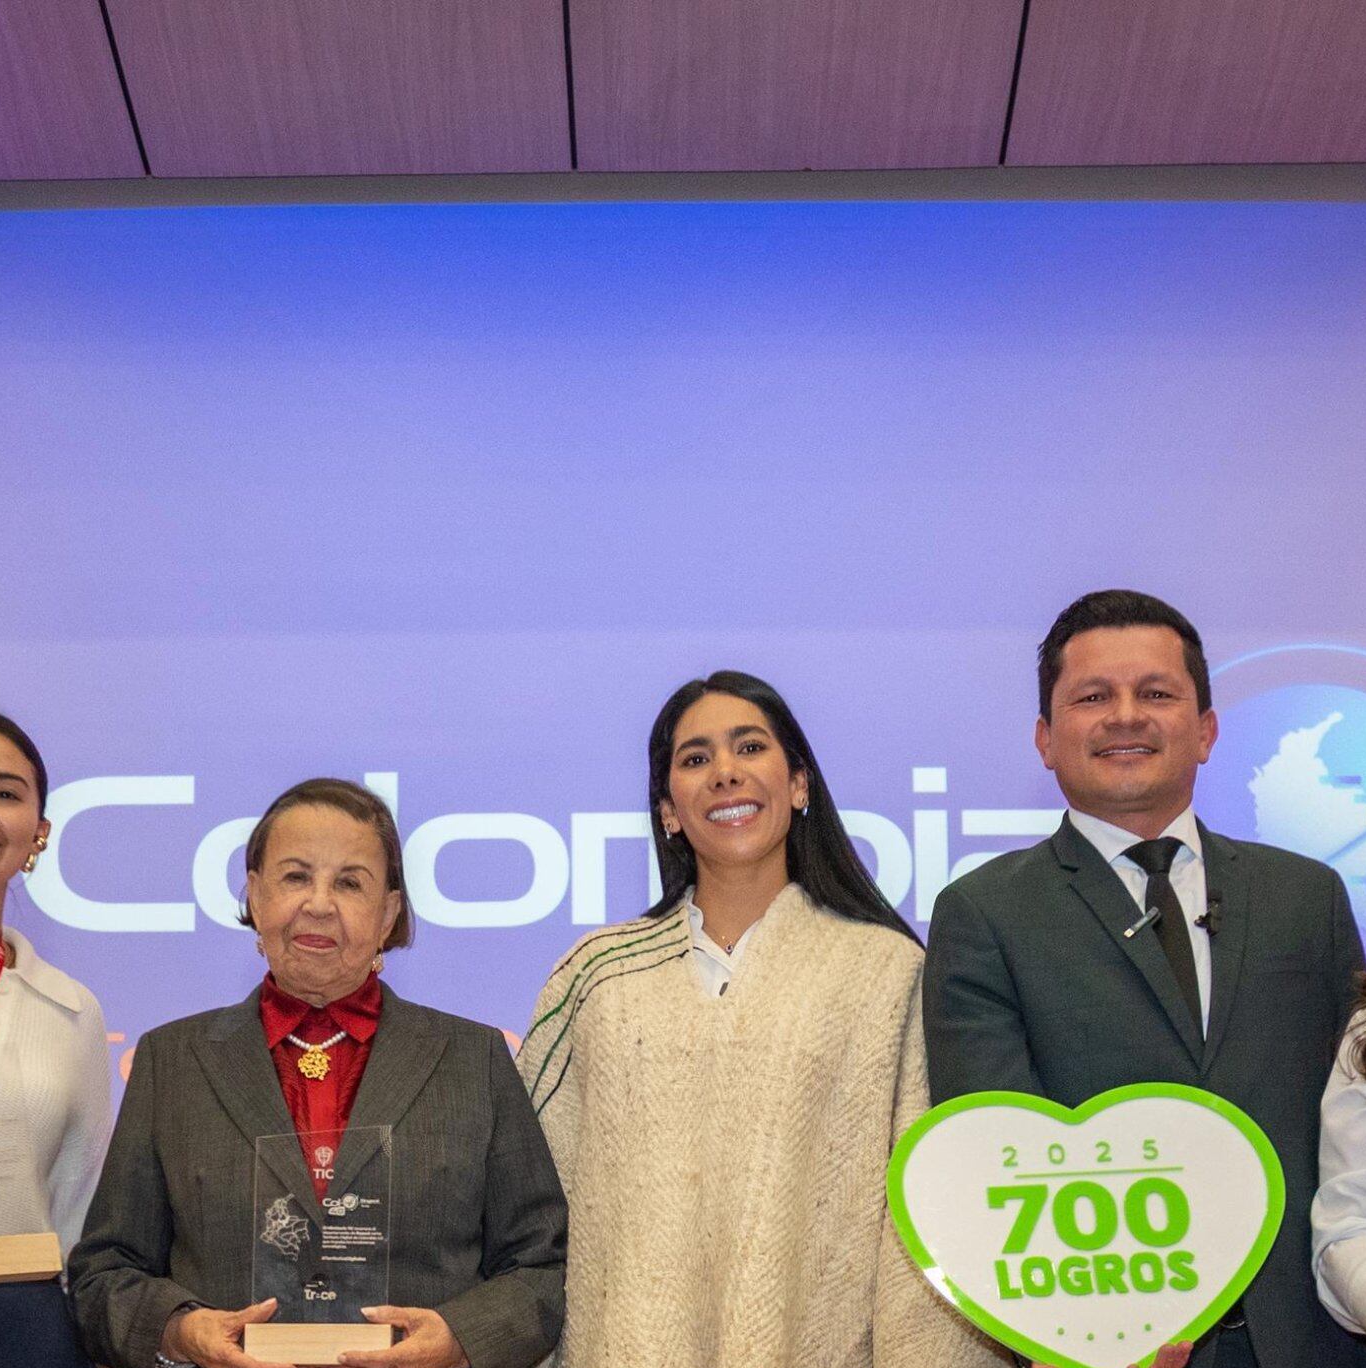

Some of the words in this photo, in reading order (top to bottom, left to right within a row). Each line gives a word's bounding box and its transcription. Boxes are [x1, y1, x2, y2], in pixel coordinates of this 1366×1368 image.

[1002, 1139, 1159, 1167] 2025
[313, 1168, 334, 1180] TIC
[986, 1177, 1191, 1254] 700
[994, 1250, 1199, 1300] LOGROS
